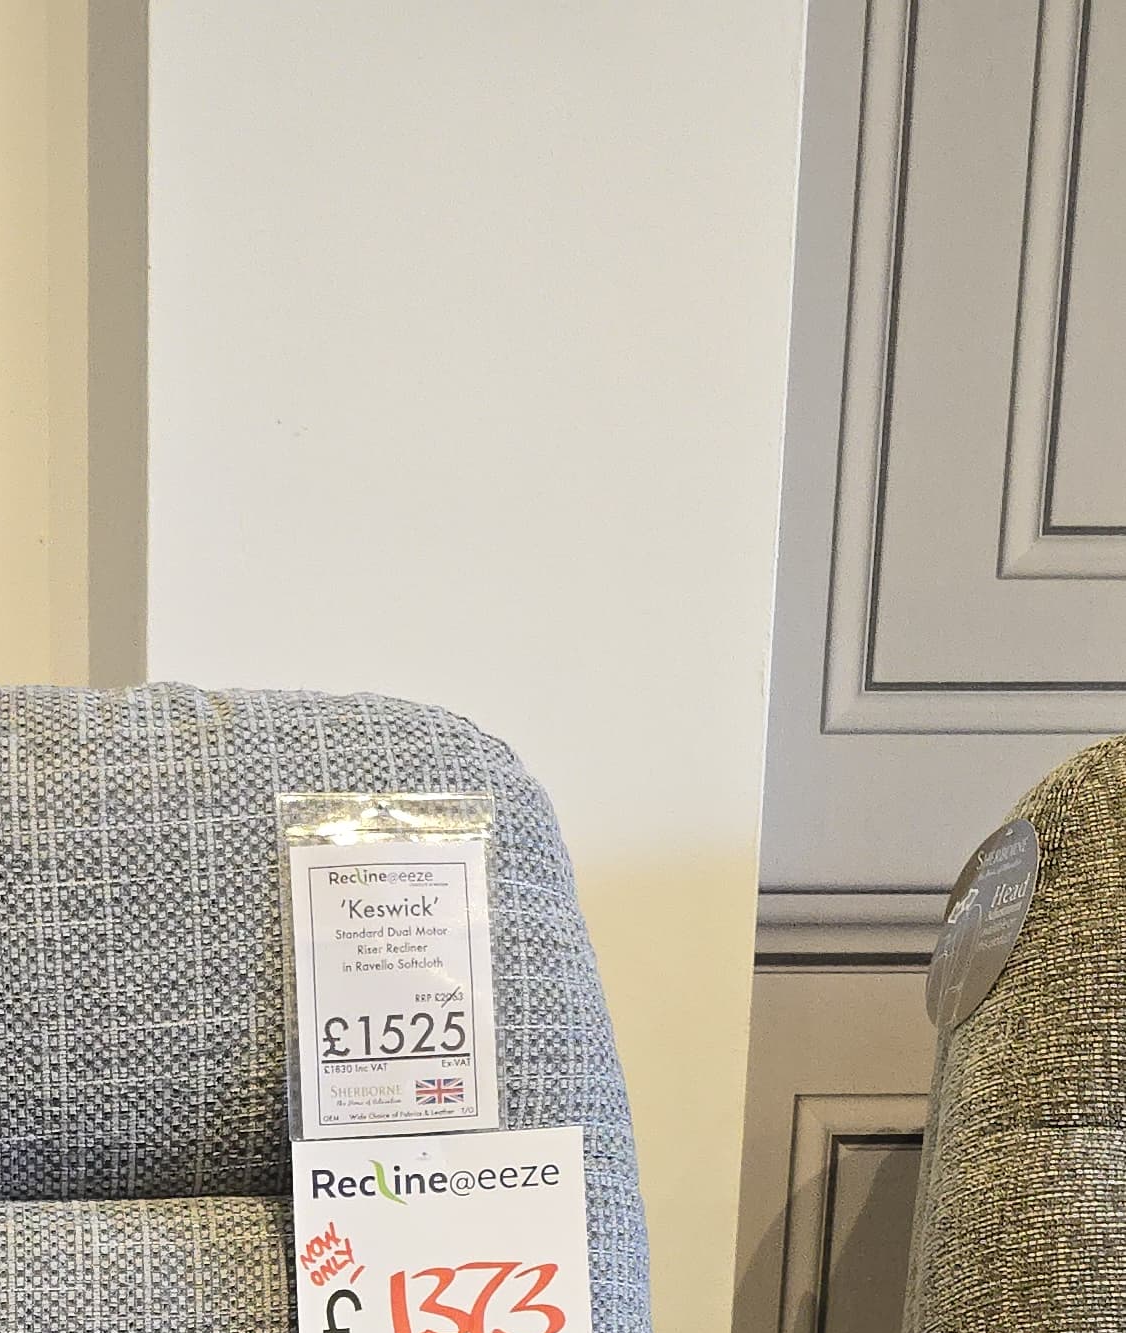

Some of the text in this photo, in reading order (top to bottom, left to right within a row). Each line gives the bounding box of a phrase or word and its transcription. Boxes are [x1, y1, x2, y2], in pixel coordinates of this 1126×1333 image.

[991, 872, 1031, 908] Head
[335, 926, 448, 940] Standard Dual Motor
[357, 942, 428, 955] Riser Recliner
[342, 957, 443, 972] in Ravello Softcloth
[322, 1011, 466, 1058] £1525
[370, 1063, 388, 1072] VAT
[330, 1084, 402, 1099] SHERBORNE
[300, 1222, 341, 1269] NOW
